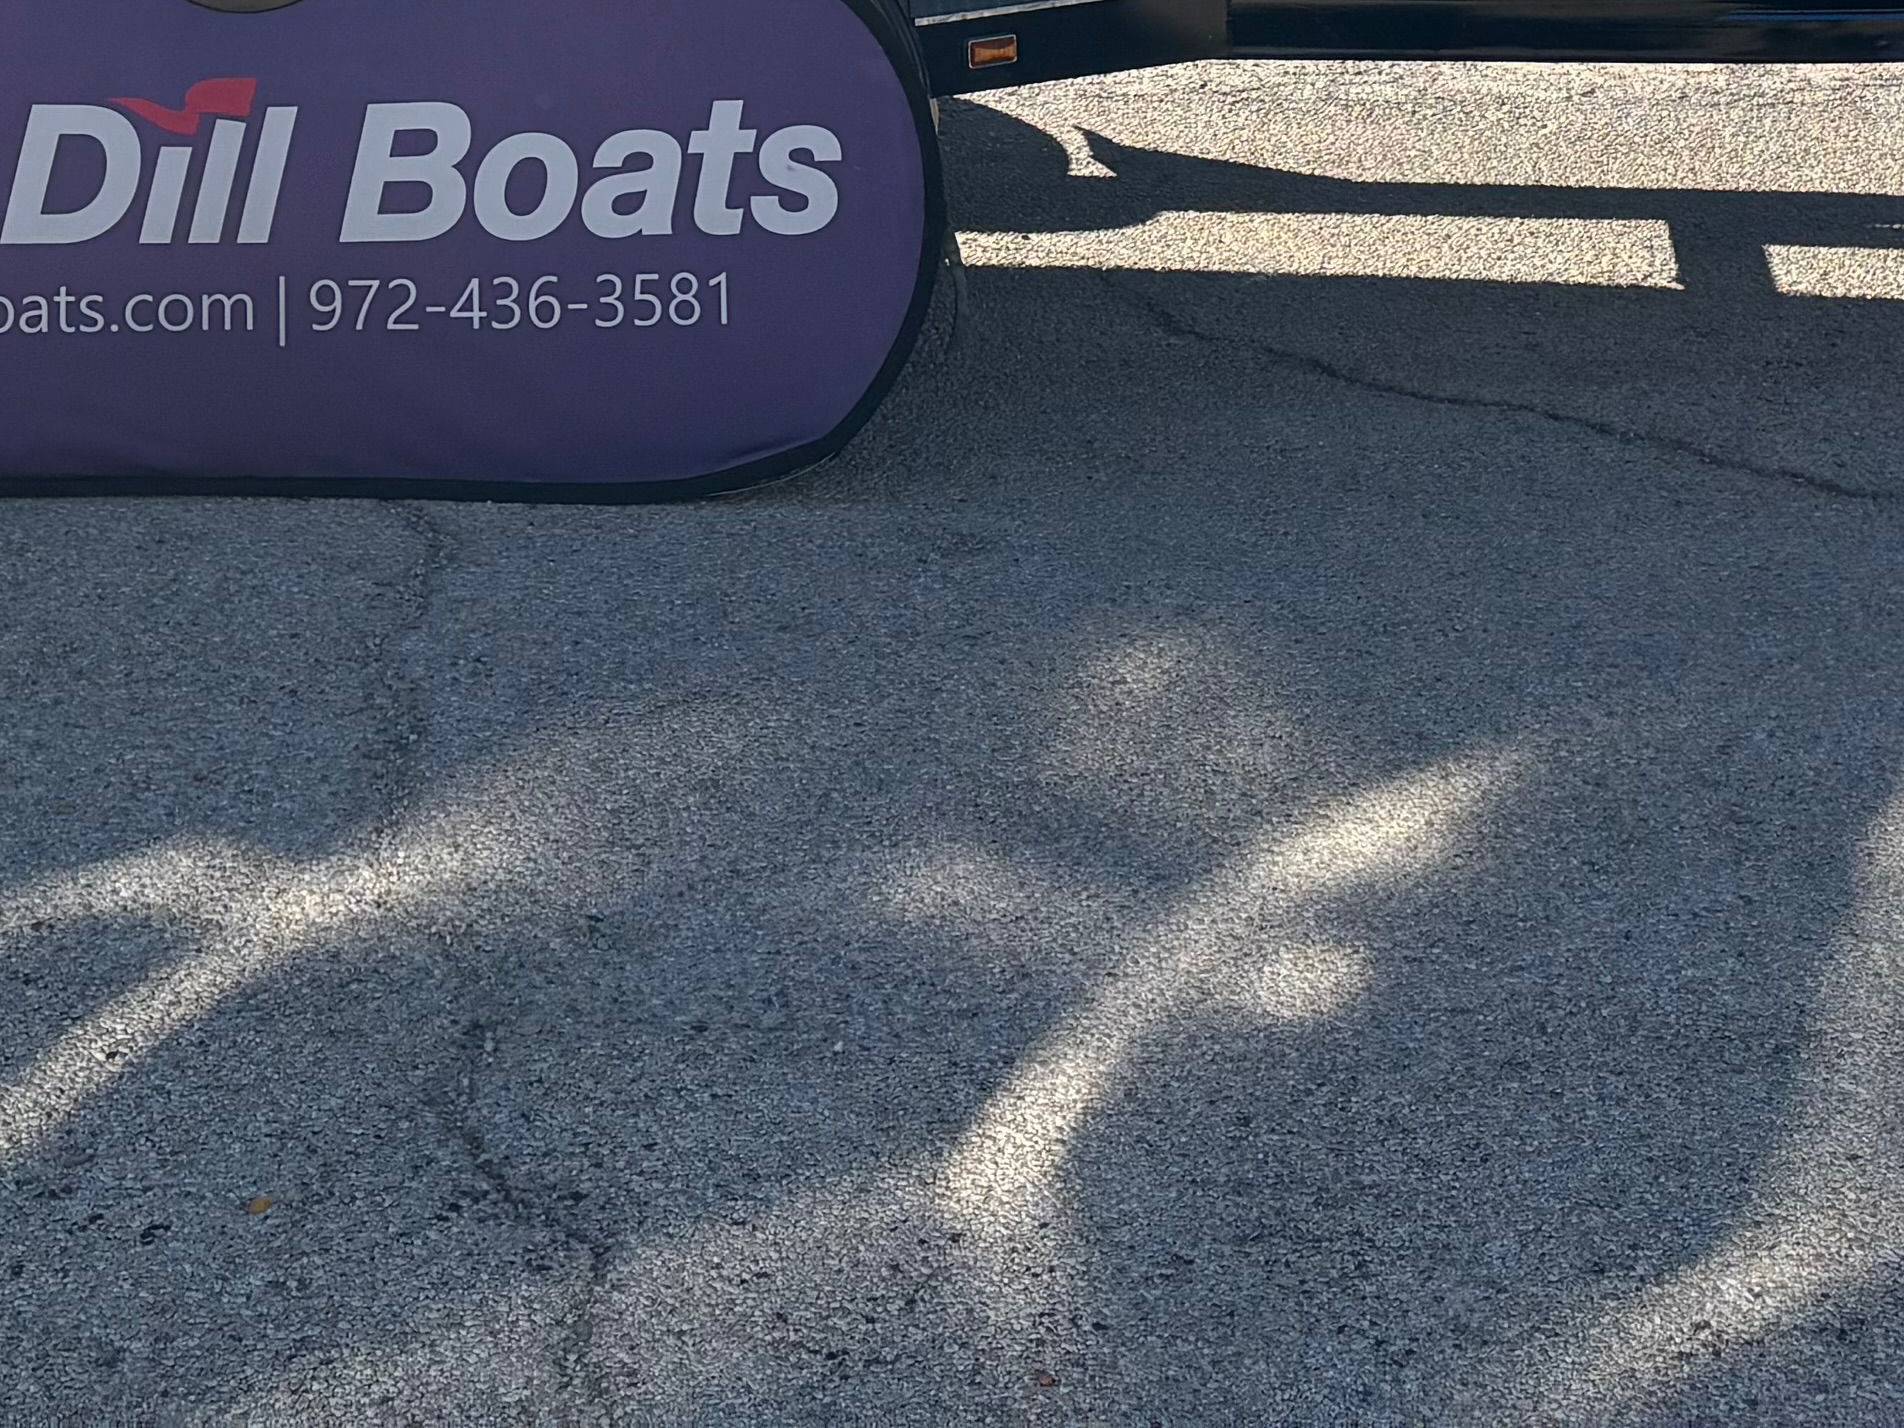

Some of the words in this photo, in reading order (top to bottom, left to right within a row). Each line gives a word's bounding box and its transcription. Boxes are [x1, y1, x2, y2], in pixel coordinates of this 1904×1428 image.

[0, 102, 298, 245] Dill
[339, 99, 843, 243] Boats
[308, 271, 731, 332] 972-436-3581
